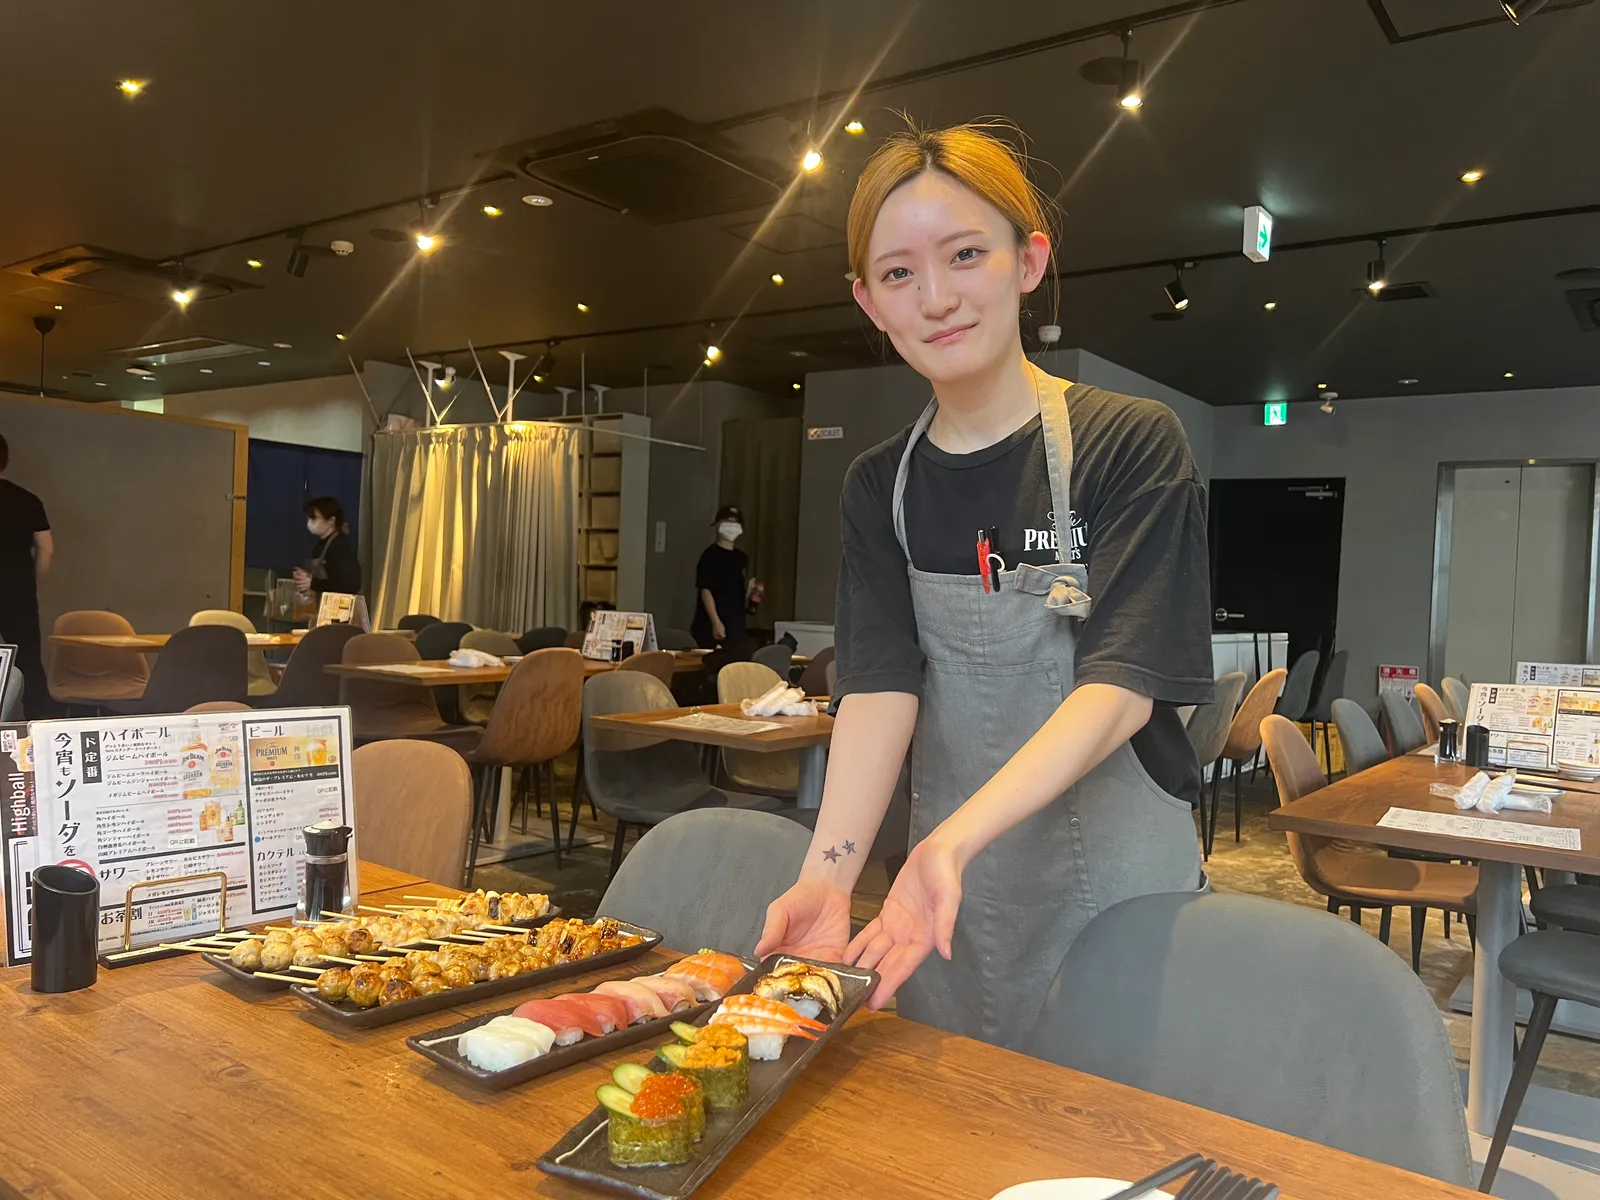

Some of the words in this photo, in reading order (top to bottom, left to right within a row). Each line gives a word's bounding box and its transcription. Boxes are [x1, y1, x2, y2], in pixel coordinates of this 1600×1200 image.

[103, 726, 171, 741] ハイボール
[250, 725, 284, 737] ビール
[84, 737, 98, 778] ド定番
[105, 751, 168, 762] ジムビームハイボール
[256, 747, 287, 757] PREMIUM
[54, 732, 80, 857] 今宵もソーダを
[8, 772, 30, 835] Highball
[257, 848, 295, 861] カクテル
[99, 867, 140, 881] サワー
[146, 866, 174, 874] レモンサワー
